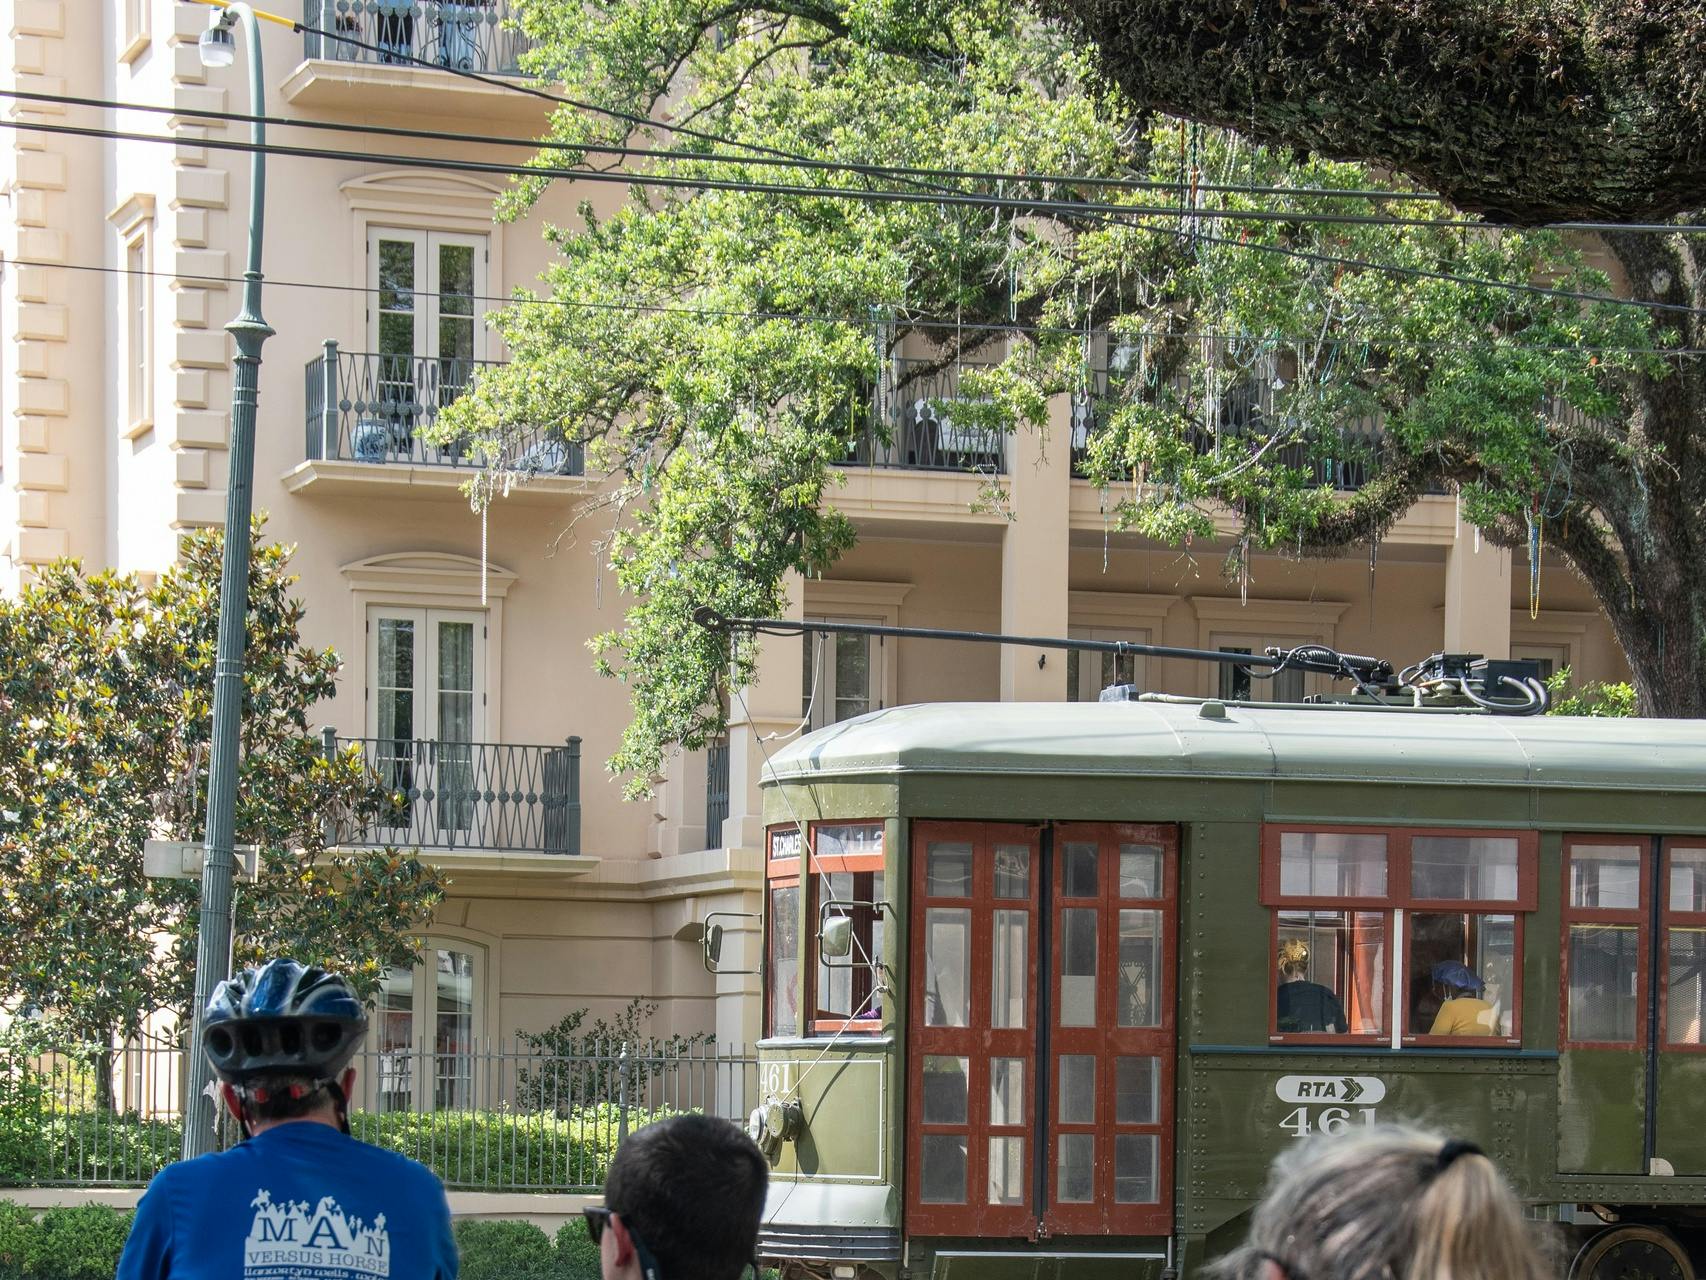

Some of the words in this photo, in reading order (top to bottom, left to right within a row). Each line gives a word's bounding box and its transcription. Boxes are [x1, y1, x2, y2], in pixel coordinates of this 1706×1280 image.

[760, 1063, 790, 1093] 461
[1298, 1081, 1336, 1097] RTA
[1279, 1107, 1376, 1137] 461
[258, 1216, 386, 1257] MAN
[249, 1250, 323, 1265] VERSUS
[329, 1253, 388, 1273] HORSE
